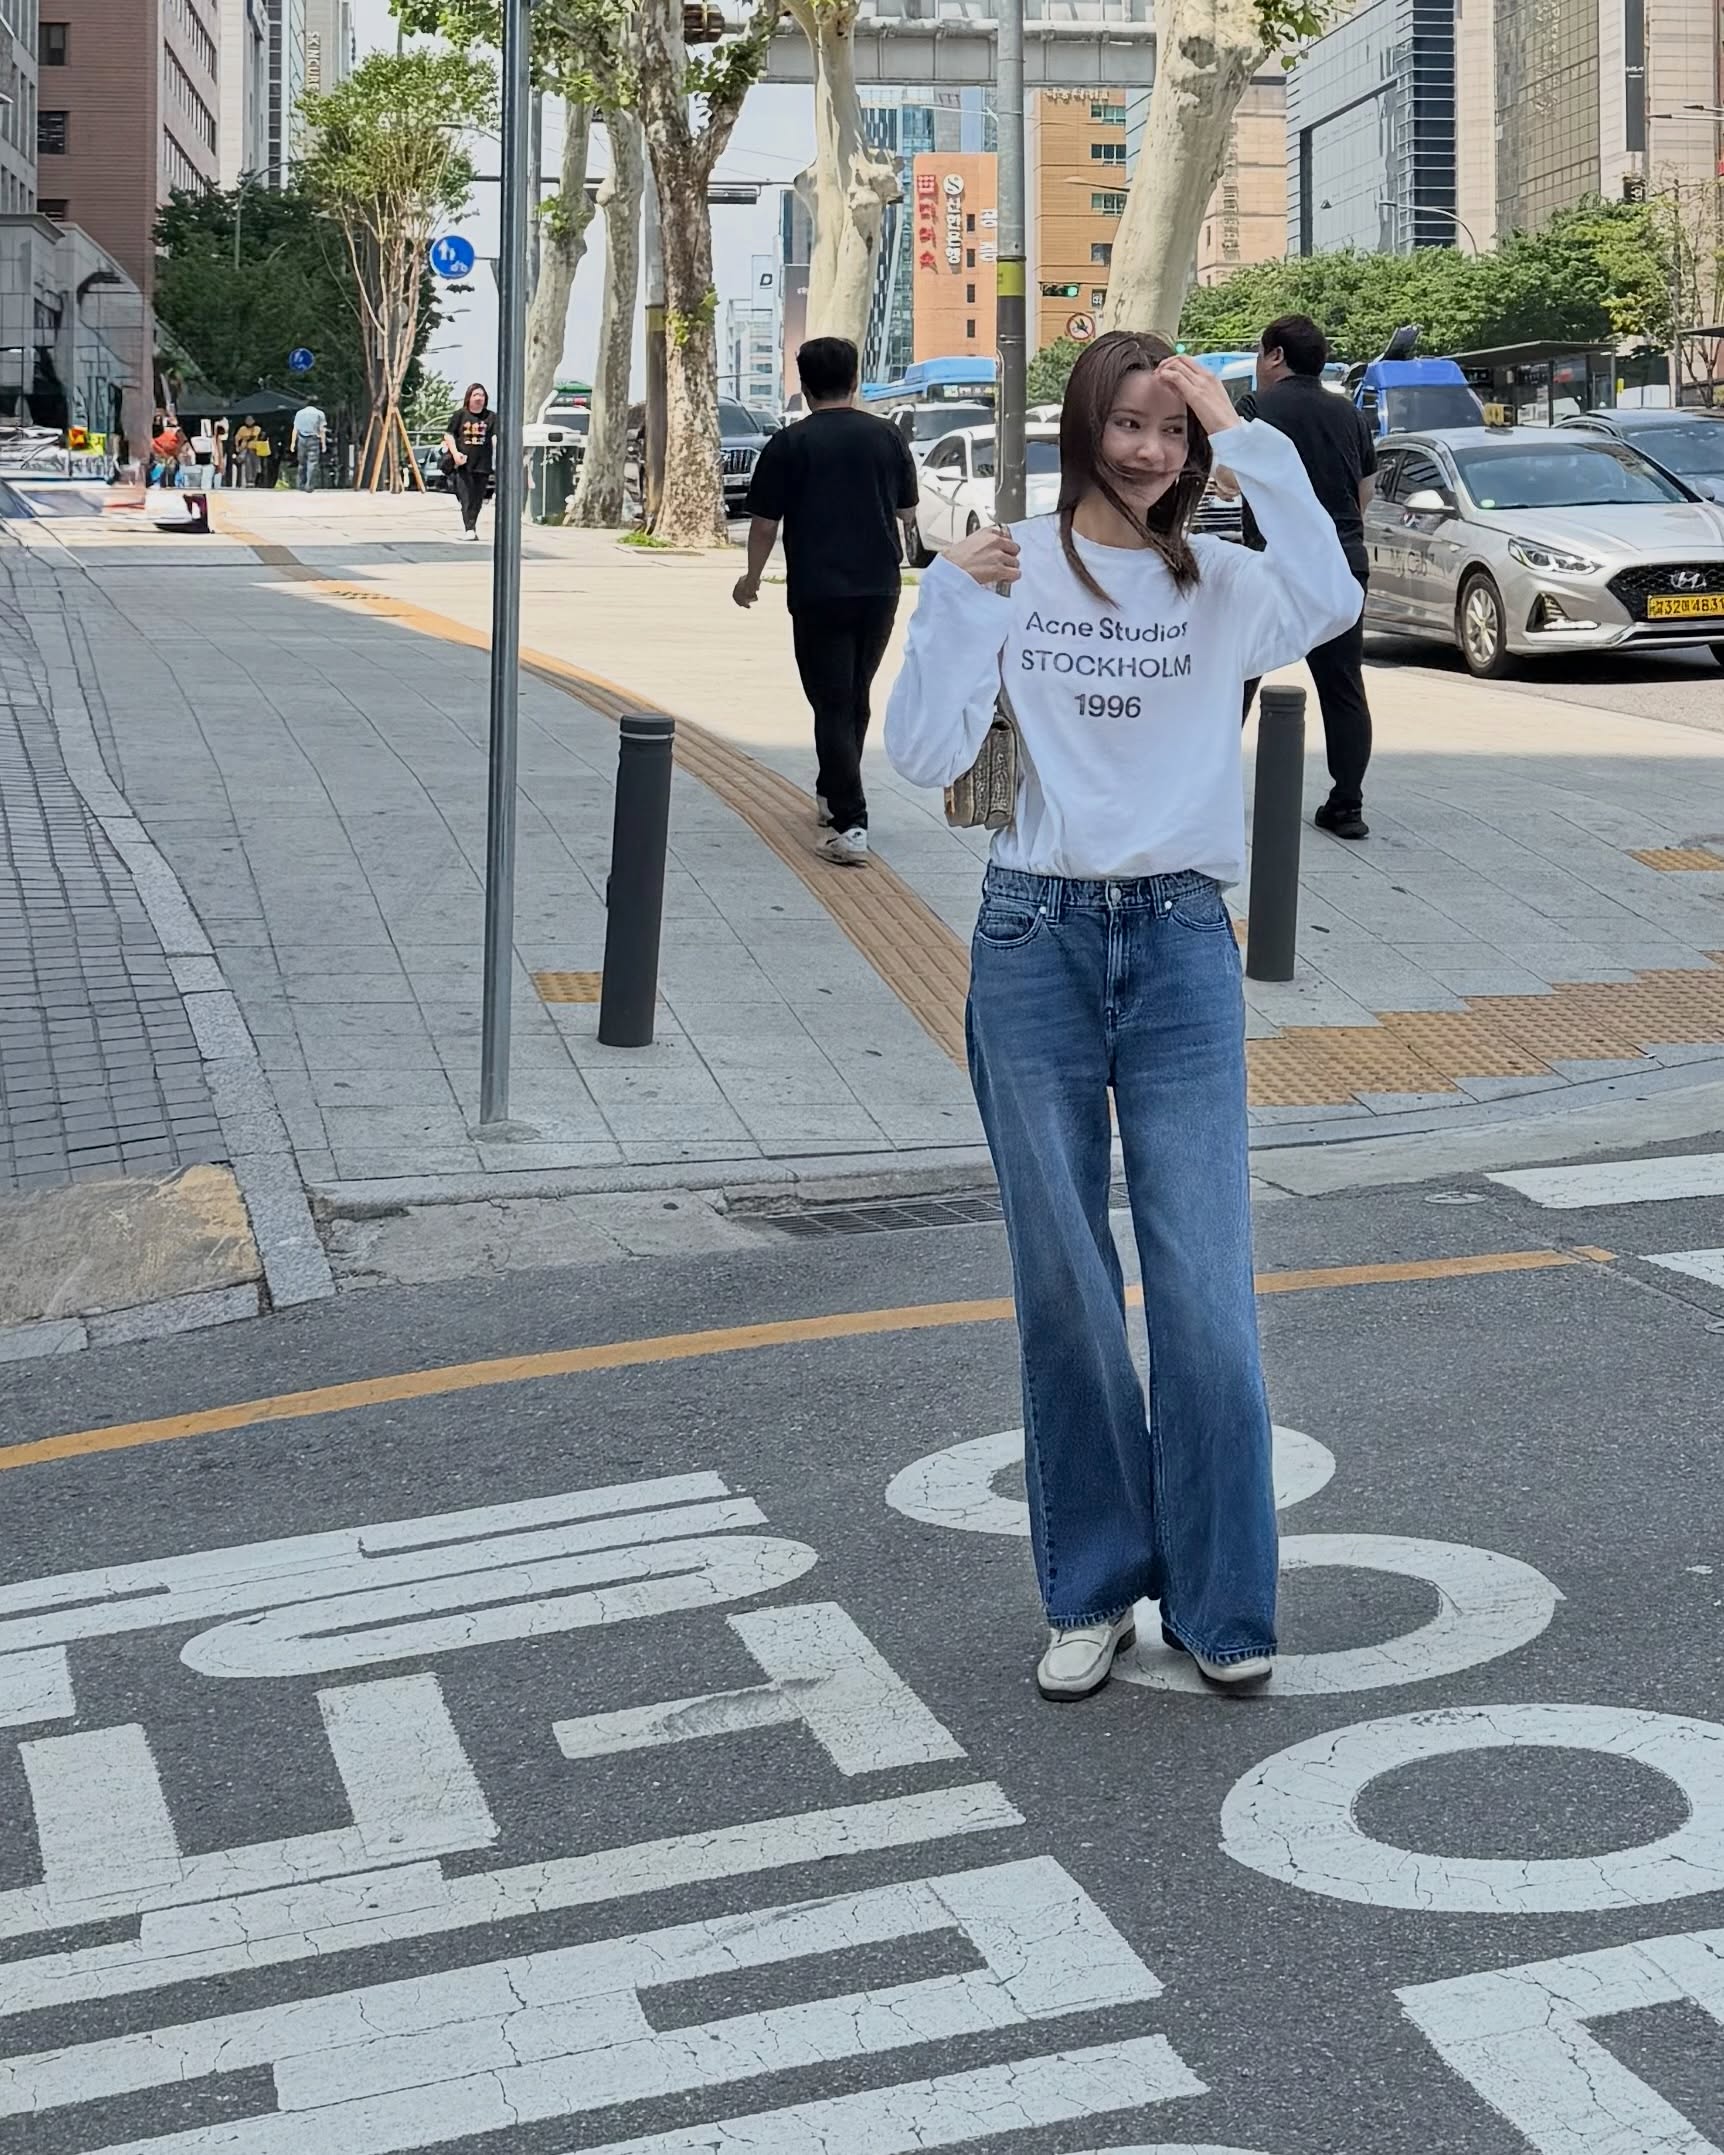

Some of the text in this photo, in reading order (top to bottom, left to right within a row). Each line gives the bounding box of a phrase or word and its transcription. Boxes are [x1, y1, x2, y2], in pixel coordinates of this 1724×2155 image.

[1026, 611, 1093, 637] Acne
[1021, 649, 1192, 678] STOCKHOLM
[1074, 693, 1142, 719] 1996
